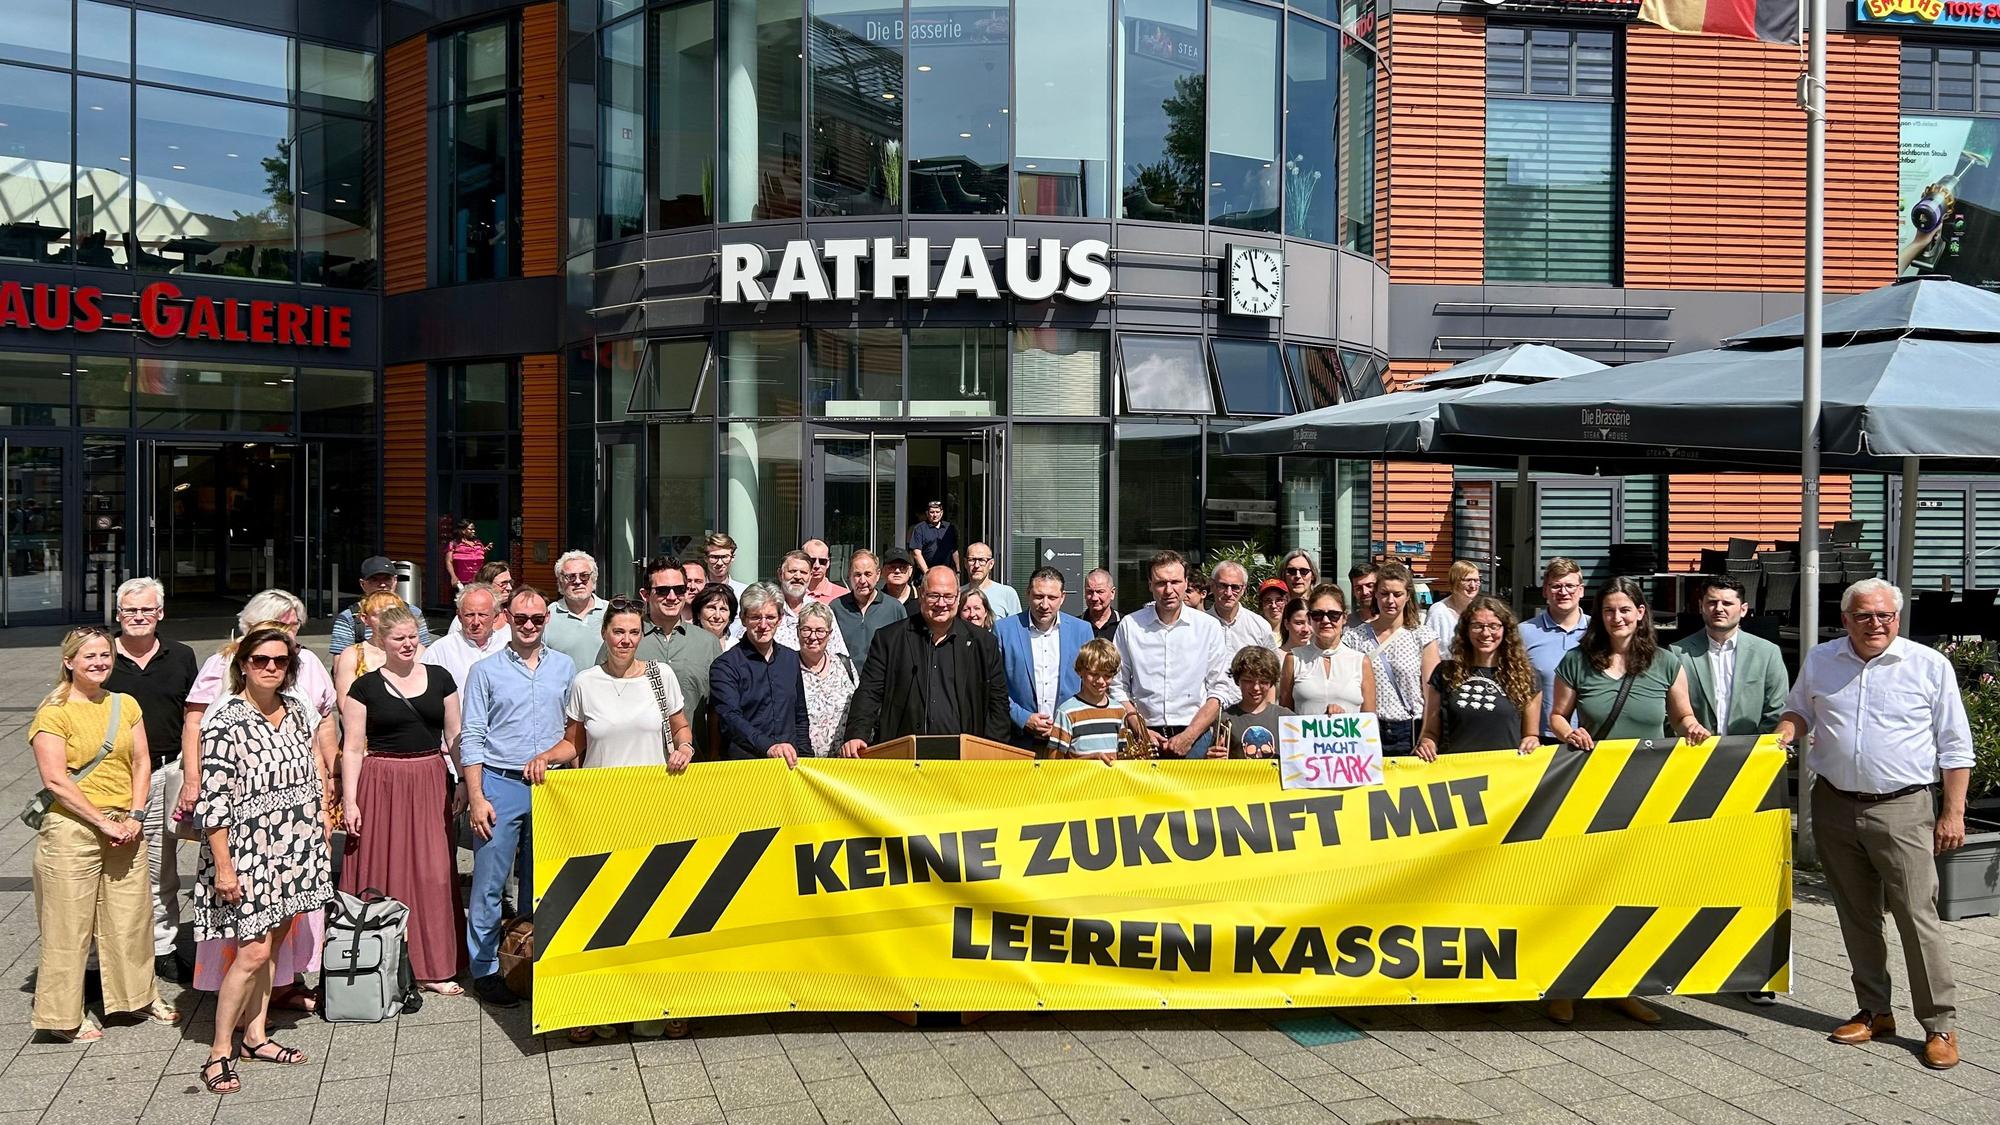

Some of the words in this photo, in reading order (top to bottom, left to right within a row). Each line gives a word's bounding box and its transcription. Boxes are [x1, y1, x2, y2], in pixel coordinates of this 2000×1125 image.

[1948, 2, 1983, 16] TOYS
[866, 20, 890, 41] Die
[894, 19, 962, 40] Basserie
[1913, 141, 1931, 149] macht
[721, 237, 1112, 301] RATHAUS
[0, 281, 351, 348] AUS-GALERIE
[1582, 408, 1594, 425] Die
[1595, 408, 1631, 426] Brasserie
[1584, 431, 1600, 440] STEAK
[1609, 432, 1628, 440] HOUSE
[1302, 718, 1362, 738] MUSIK
[1313, 741, 1358, 754] MACHT
[1305, 754, 1374, 783] STARK
[795, 828, 1001, 896] KEINE
[1020, 793, 1347, 876] ZUKUNFT
[1369, 775, 1489, 841] MIT
[952, 906, 1211, 974] LEEREN
[1233, 924, 1518, 980] KASSEN
